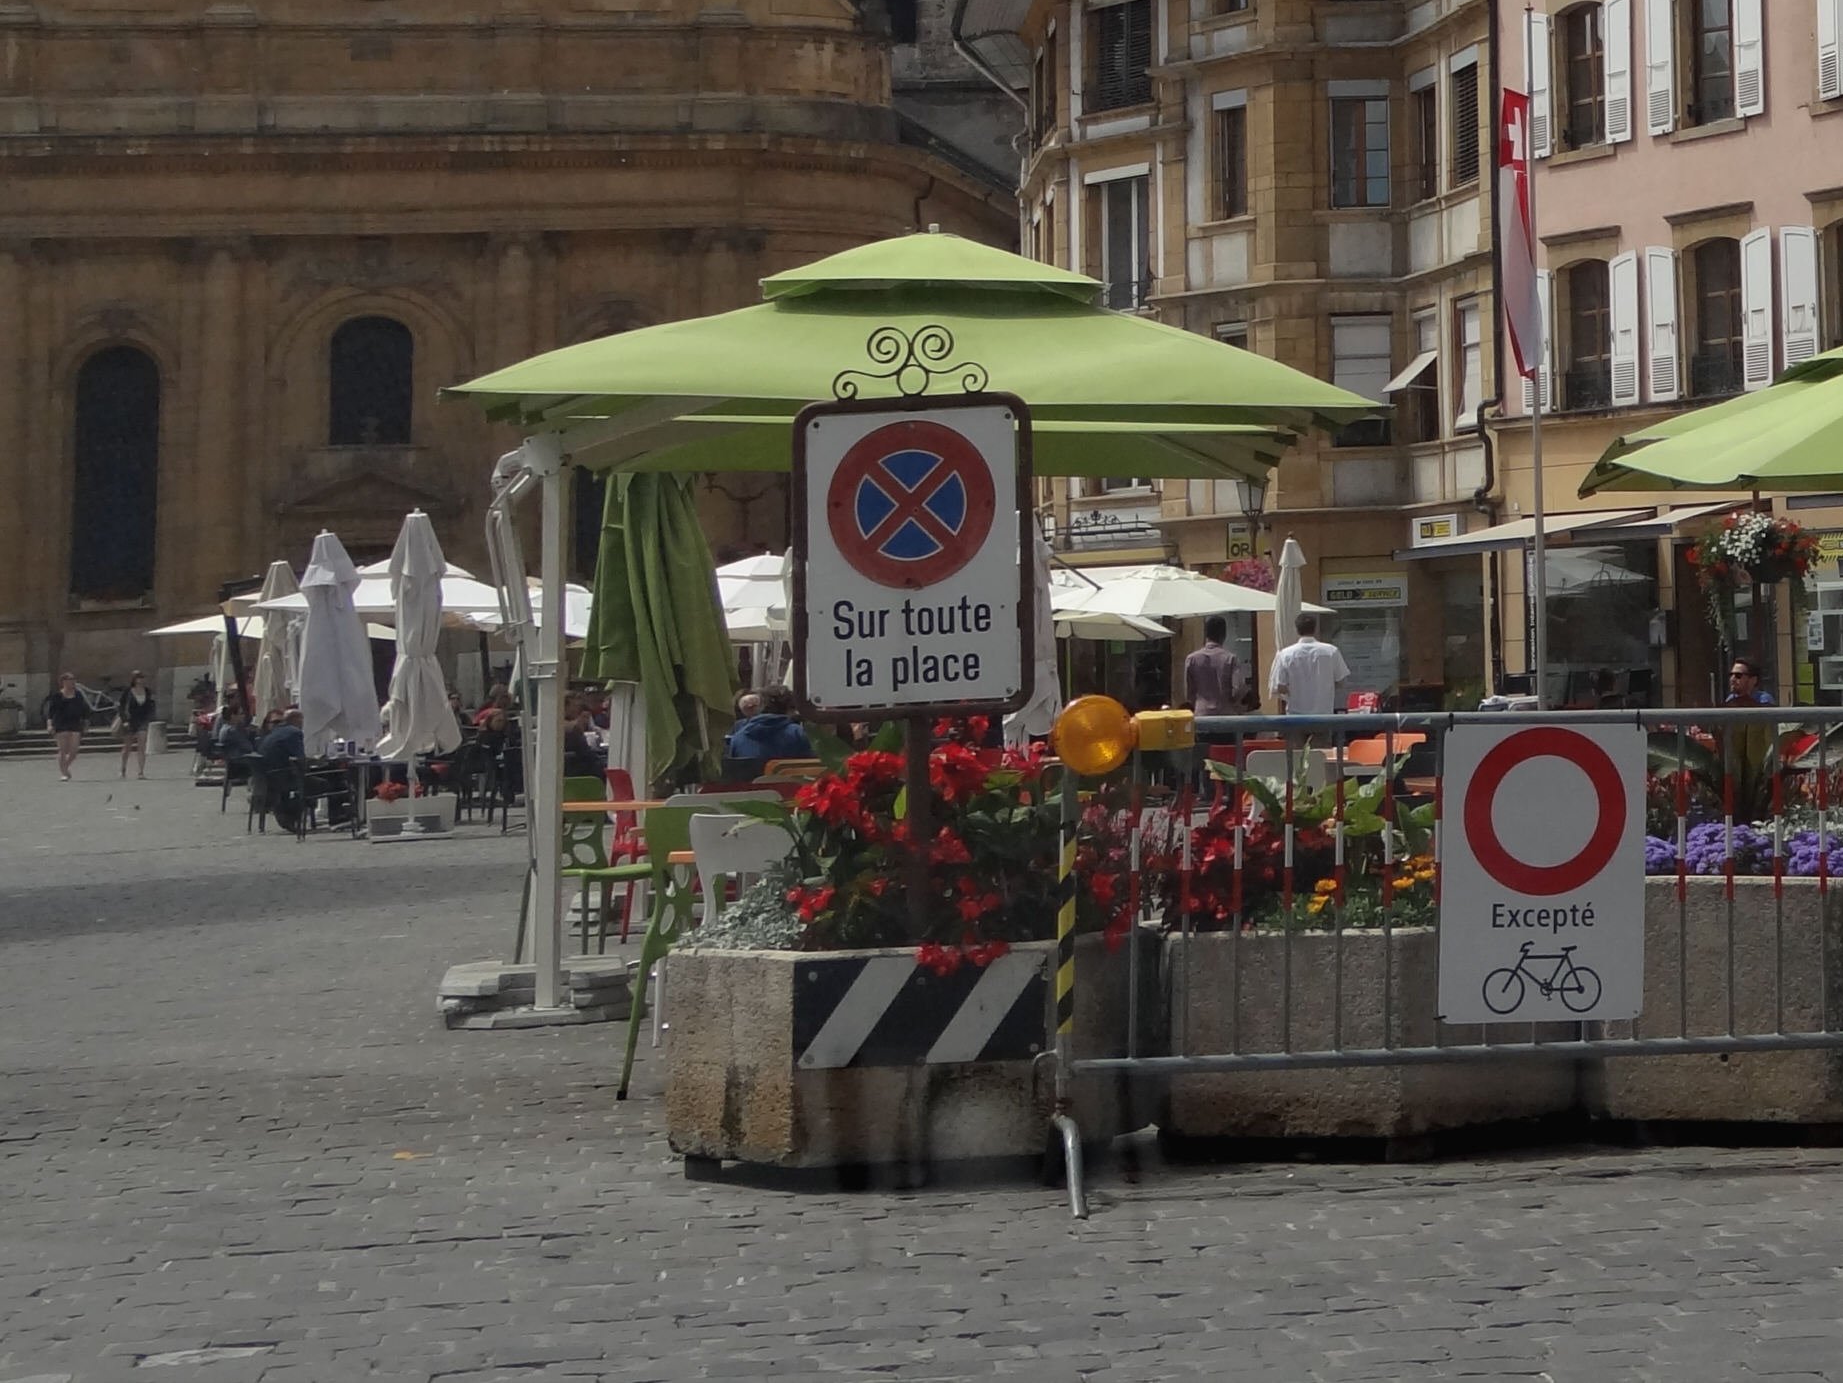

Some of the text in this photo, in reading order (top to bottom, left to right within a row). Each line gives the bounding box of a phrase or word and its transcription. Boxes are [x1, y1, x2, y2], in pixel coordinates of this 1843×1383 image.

[833, 595, 991, 640] Sur toute
[846, 645, 980, 691] la place
[1492, 902, 1595, 934] Excepté
